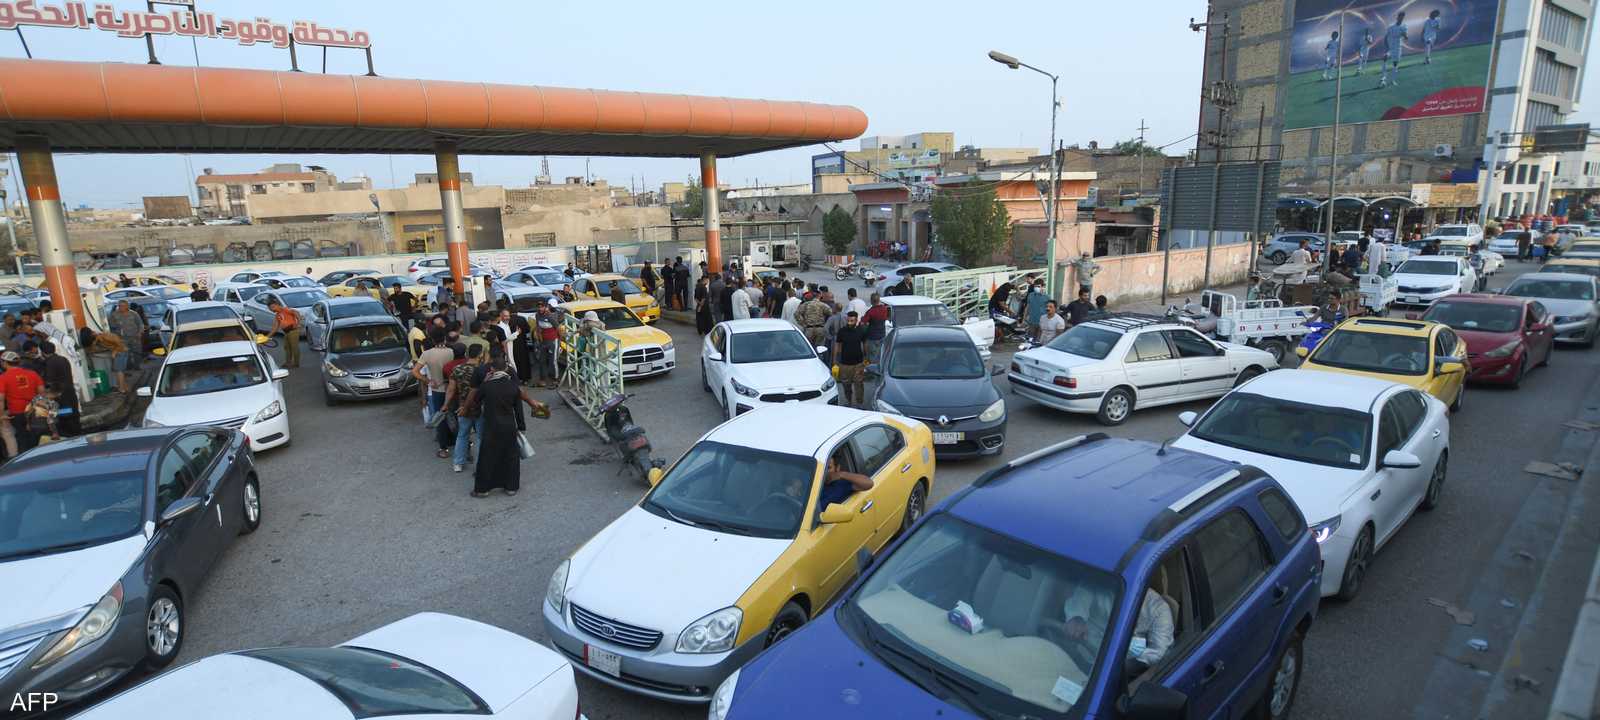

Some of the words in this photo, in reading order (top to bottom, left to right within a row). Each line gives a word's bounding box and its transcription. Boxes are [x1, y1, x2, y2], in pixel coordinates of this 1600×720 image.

[95, 4, 217, 37] الناصرية
[220, 17, 290, 48] وقود
[293, 19, 370, 48] محطة
